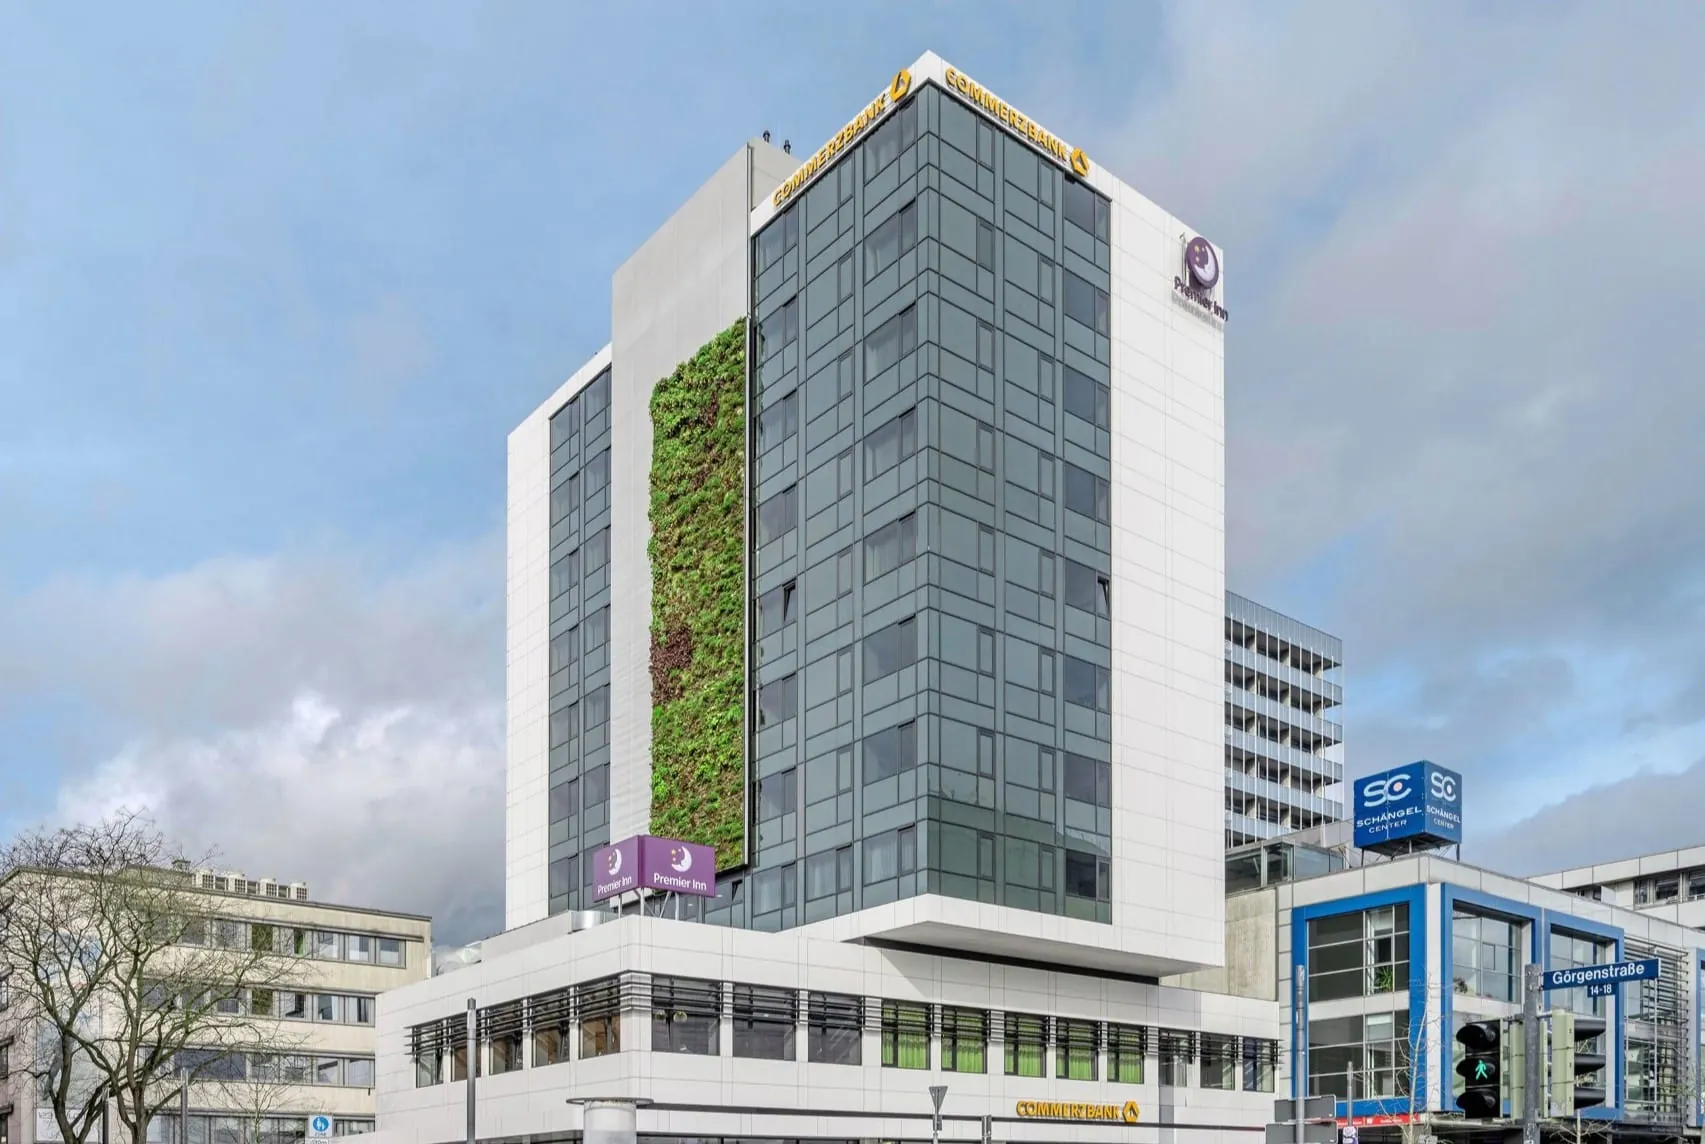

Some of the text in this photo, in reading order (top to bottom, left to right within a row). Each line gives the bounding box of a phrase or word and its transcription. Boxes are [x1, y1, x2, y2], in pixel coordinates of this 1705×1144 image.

[945, 67, 1067, 161] COMMERZBANK
[773, 93, 887, 207] COMMERZBANK
[1174, 275, 1229, 322] Premier Inn
[1368, 820, 1407, 834] CENTER
[1433, 818, 1455, 830] CENTER
[597, 876, 632, 896] Premier Inn
[654, 872, 707, 891] Premier Inn
[1552, 962, 1645, 985] Görgenstraße
[1590, 983, 1612, 996] 14-18
[1016, 1100, 1119, 1120] COMMERZBANK
